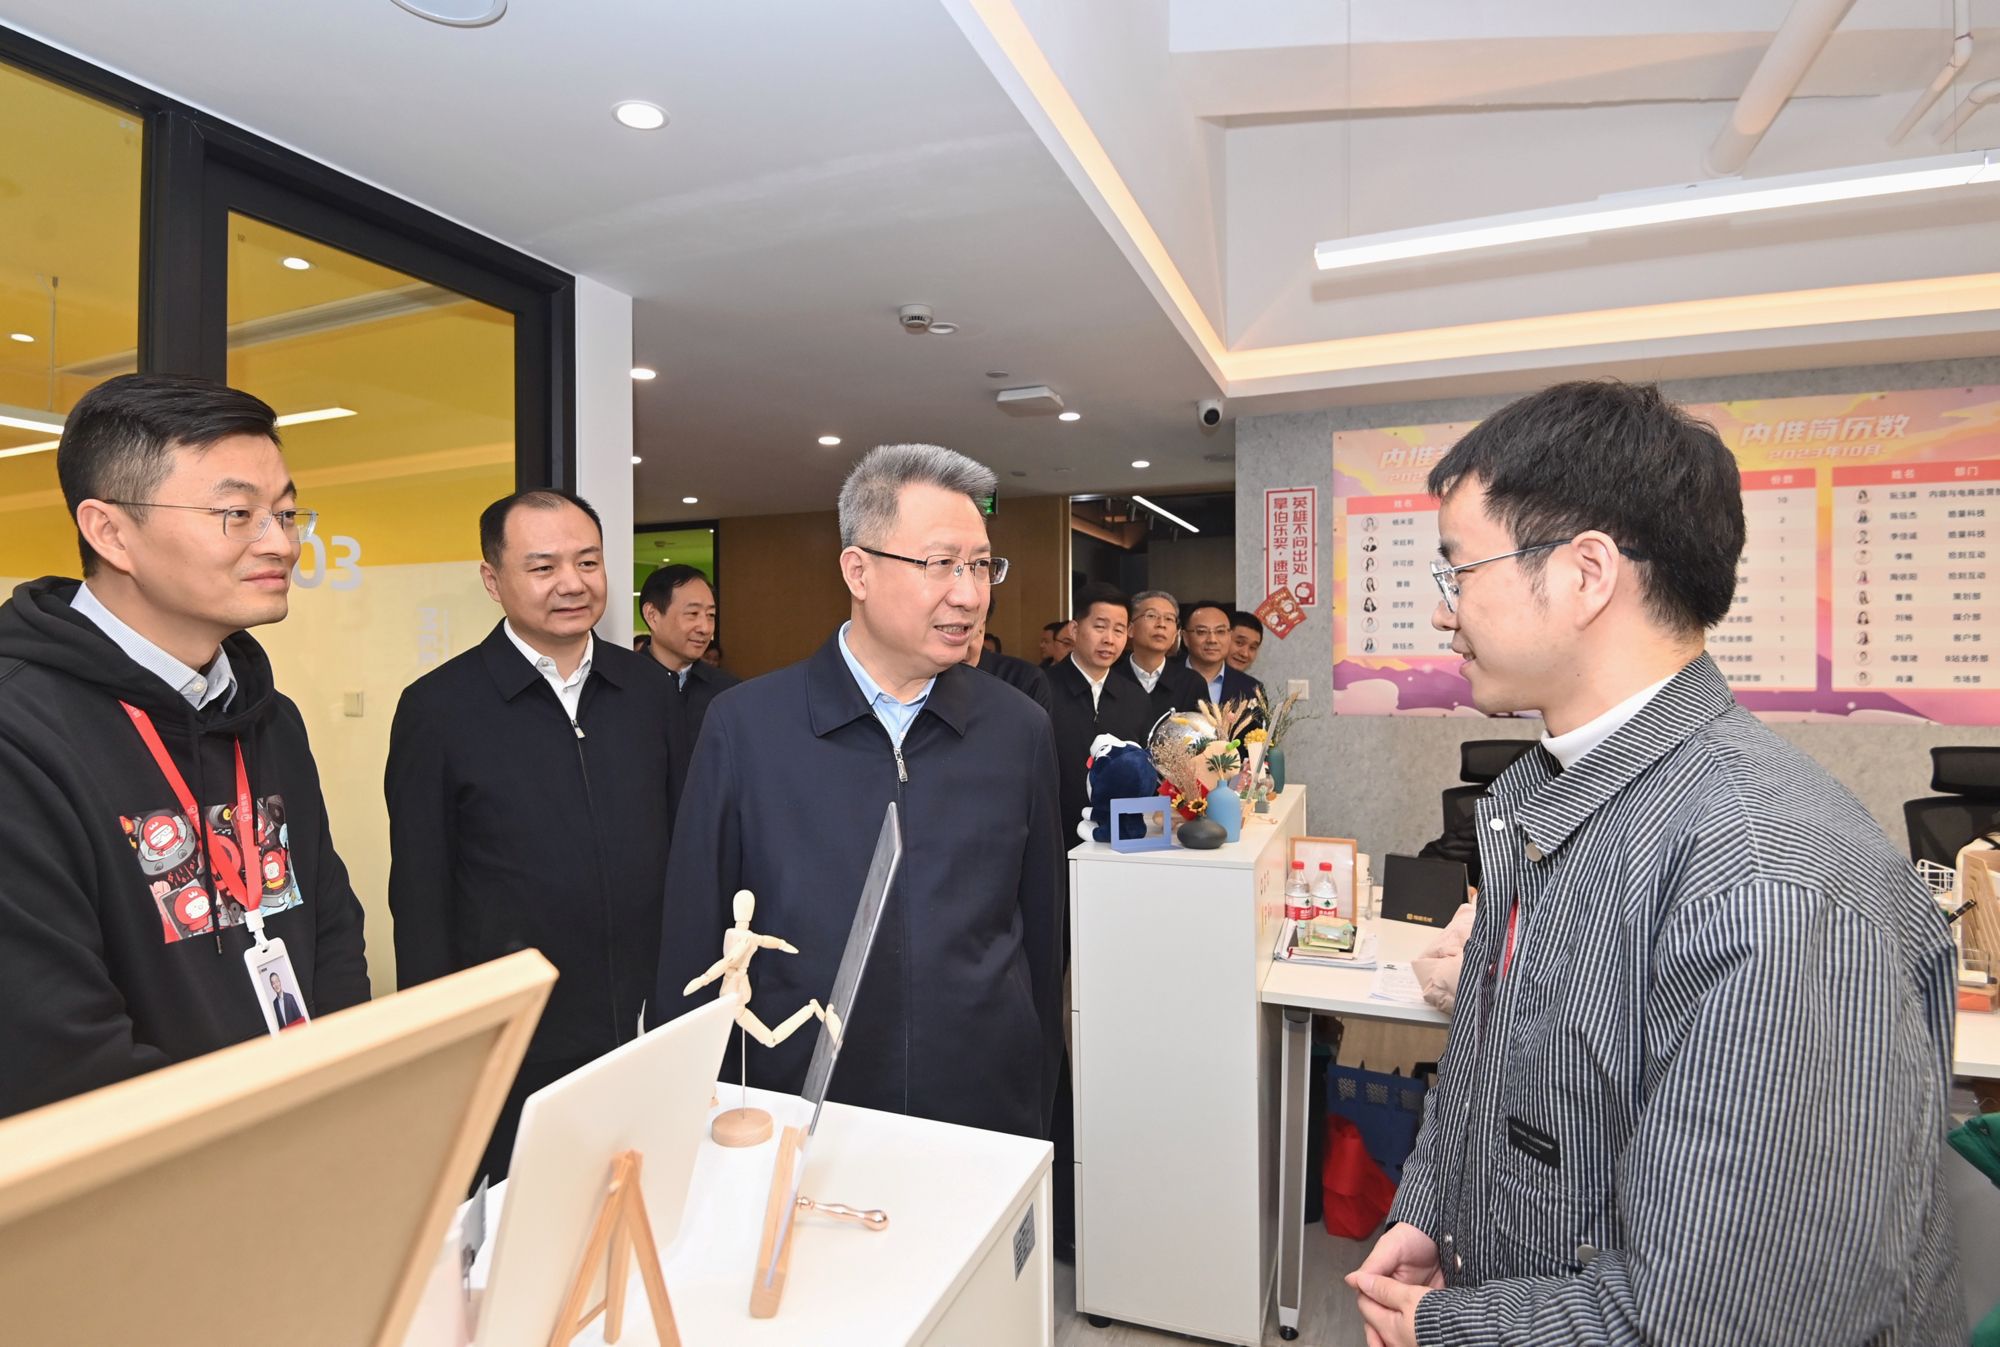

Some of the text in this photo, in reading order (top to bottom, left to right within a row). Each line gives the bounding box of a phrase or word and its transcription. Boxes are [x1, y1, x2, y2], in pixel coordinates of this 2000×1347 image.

[1741, 414, 1910, 445] 内推简历数
[1768, 443, 1881, 460] 2023年10月
[1891, 466, 1979, 480] 姓名 部门
[1292, 496, 1308, 576] 英雄不问出处
